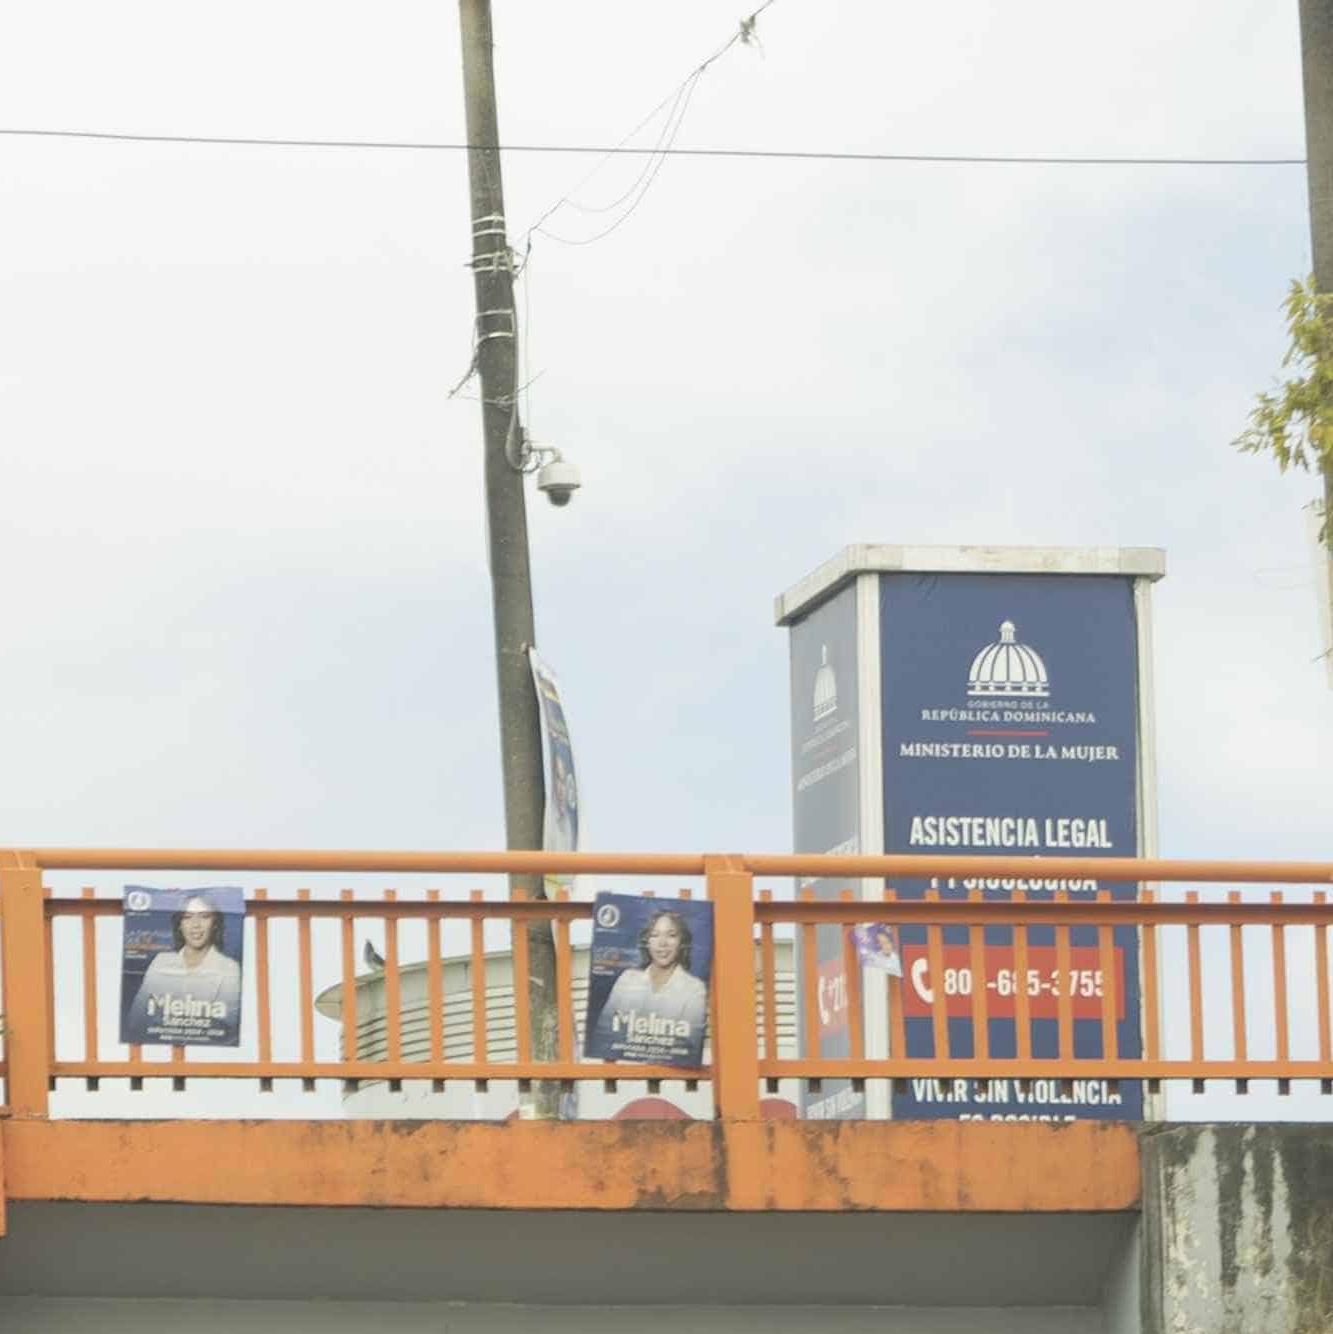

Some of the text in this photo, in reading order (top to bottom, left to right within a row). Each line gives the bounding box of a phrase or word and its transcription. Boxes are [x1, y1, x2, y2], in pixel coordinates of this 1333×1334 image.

[921, 708, 1096, 724] REPÚBLICA DOMINICANA
[899, 743, 1120, 762] MINISTERIO DE LA MUJER
[909, 816, 1113, 848] ASISTENCIA LEGAL
[146, 992, 227, 1019] Melina
[612, 1009, 691, 1037] Melina
